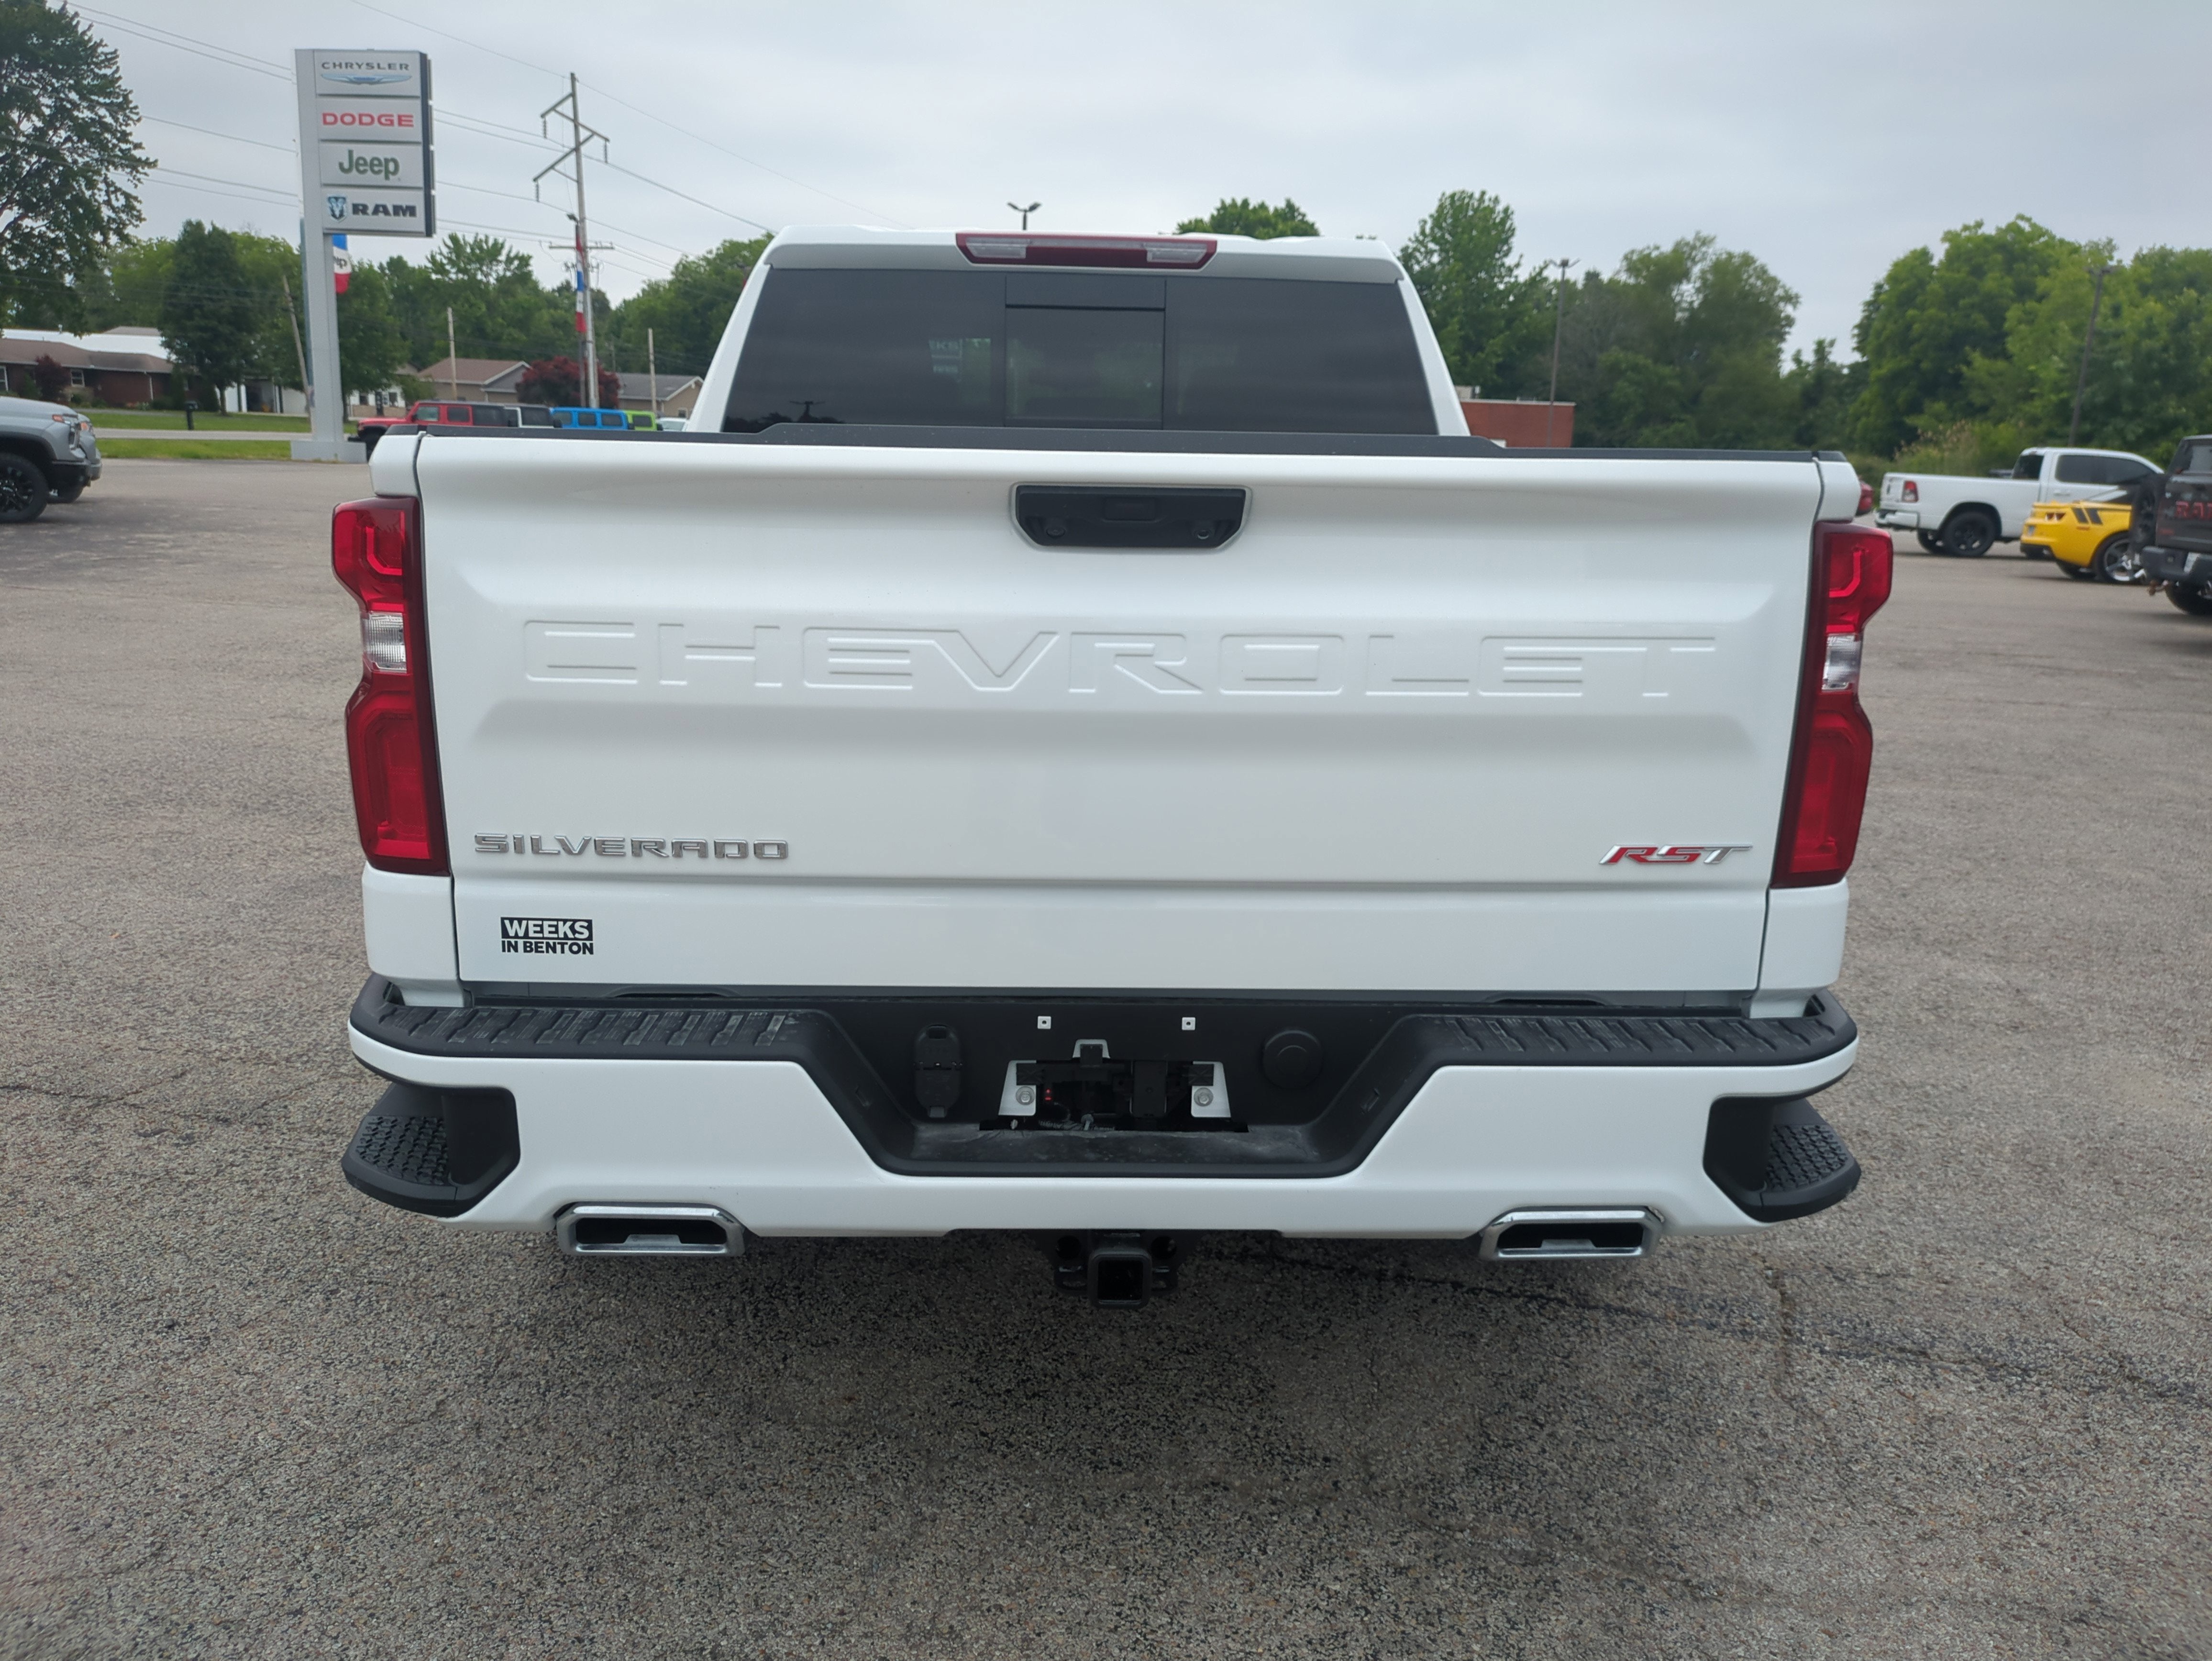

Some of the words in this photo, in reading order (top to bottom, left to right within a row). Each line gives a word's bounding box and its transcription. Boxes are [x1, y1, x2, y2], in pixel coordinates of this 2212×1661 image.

[321, 61, 410, 71] CHRYSLER
[322, 112, 414, 128] DODGE
[338, 149, 400, 181] Jeep
[352, 203, 417, 217] RAM
[2175, 500, 2212, 520] RA
[524, 619, 1716, 698] CHEVROLET
[474, 832, 788, 860] SILVERADO
[1598, 844, 1753, 865] RST
[503, 919, 589, 939] WEEKS
[501, 940, 519, 953] IN
[523, 940, 594, 955] BENTON
